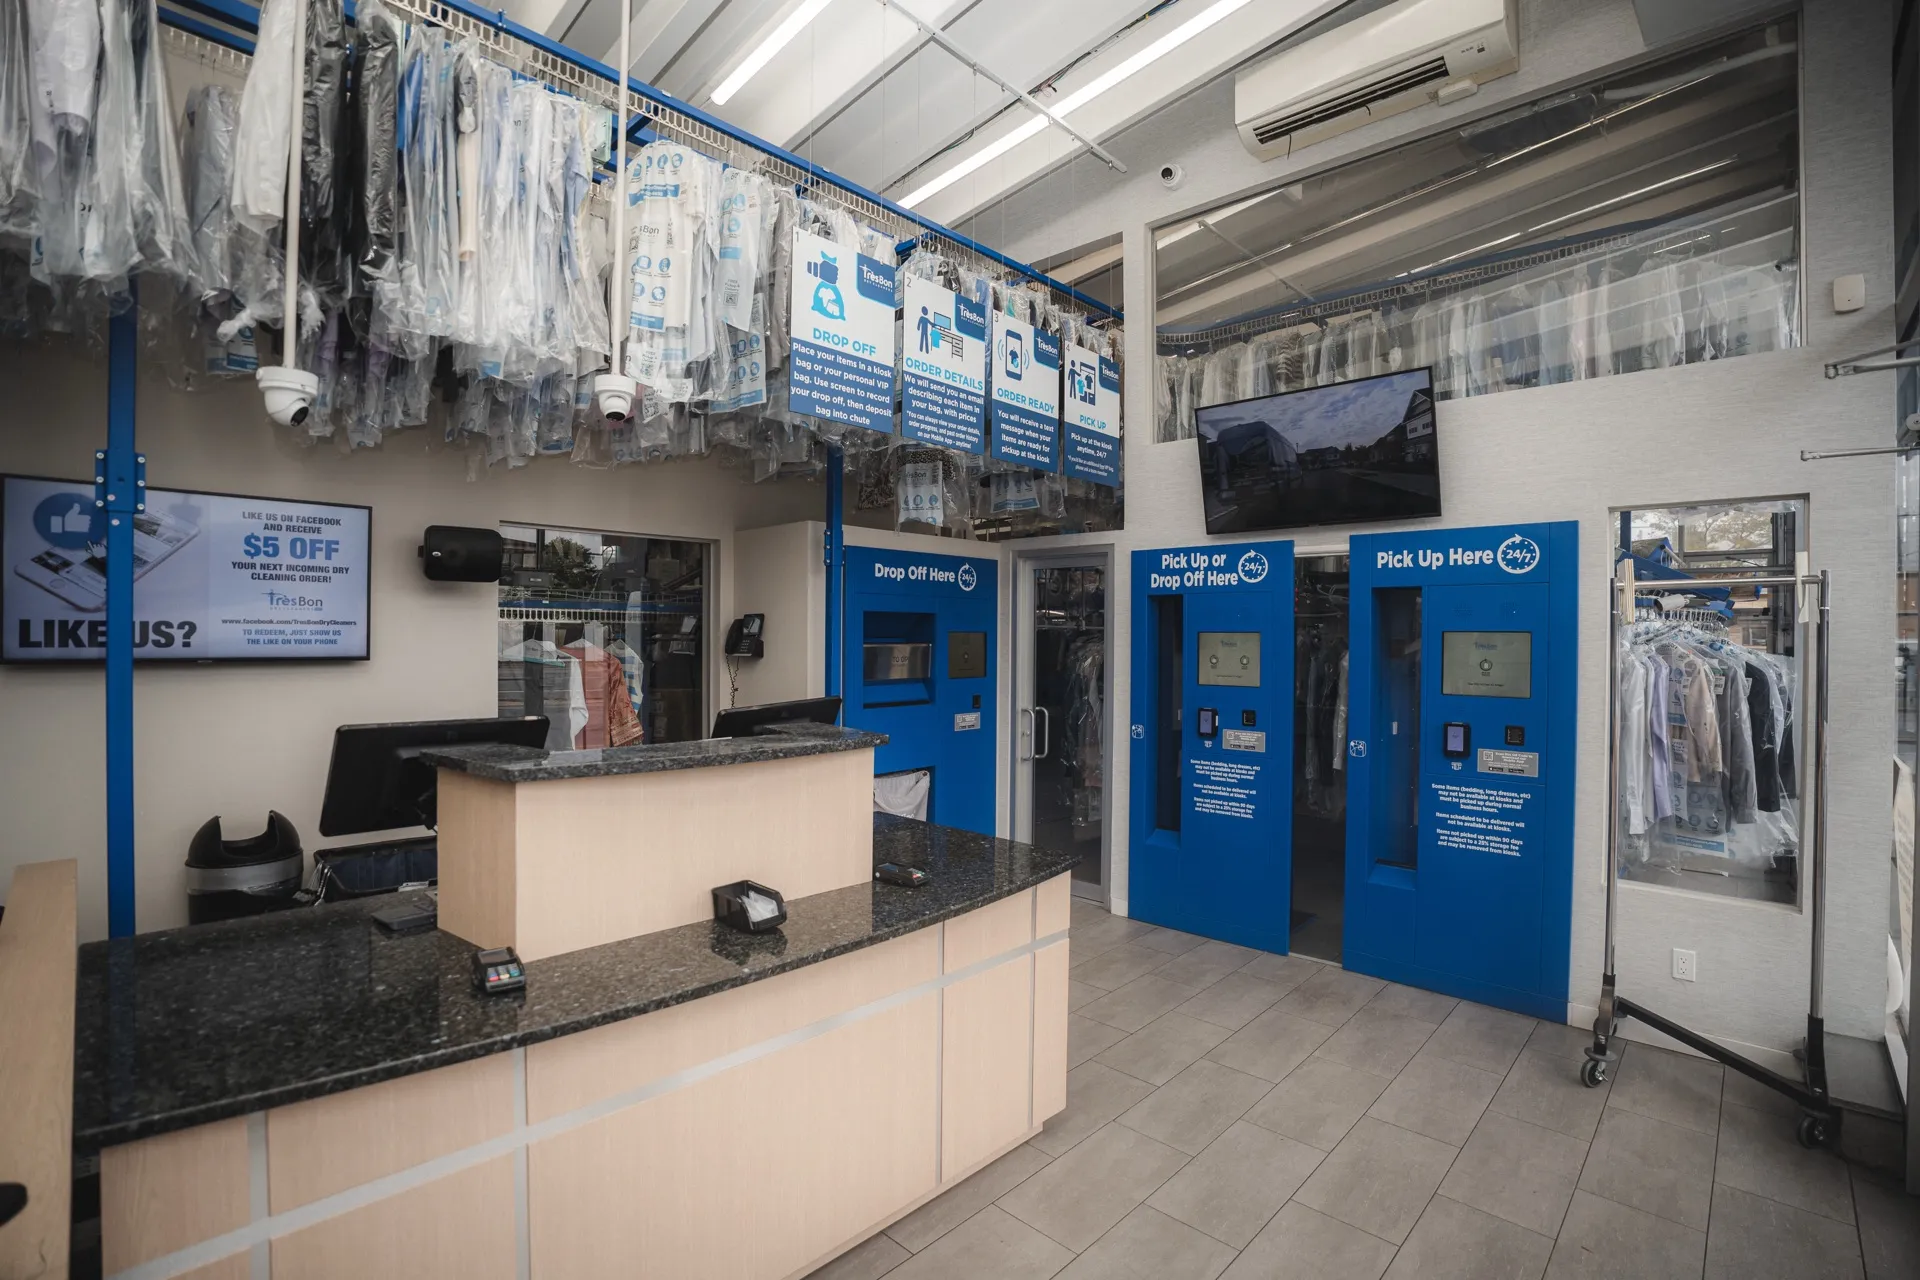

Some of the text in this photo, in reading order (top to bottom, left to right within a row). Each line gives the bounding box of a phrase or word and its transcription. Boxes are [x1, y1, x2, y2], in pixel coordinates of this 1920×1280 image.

[906, 277, 912, 288] 2
[813, 328, 876, 356] DROP OFF
[793, 342, 815, 356] Place
[817, 350, 835, 361] your
[836, 355, 857, 368] items
[859, 361, 866, 370] in
[873, 366, 892, 378] kiosk
[796, 357, 812, 370] bag
[824, 366, 842, 377] your
[844, 372, 875, 386] personal
[876, 380, 889, 389] VIP
[906, 357, 983, 391] ORDER DETAILS
[794, 371, 890, 404] bag. Use screen to record
[904, 374, 916, 384] We
[917, 379, 929, 388] will
[930, 383, 945, 393] send
[946, 388, 958, 397] you
[968, 395, 984, 405] email
[791, 386, 892, 417] your drop off, then deposit
[908, 386, 942, 404] describing
[944, 398, 958, 407] each
[960, 401, 973, 412] item
[997, 388, 1055, 414] ORDER READY
[816, 405, 870, 425] bag into chute
[912, 399, 976, 423] your bag, with prices
[998, 409, 1009, 419] You
[1020, 418, 1039, 428] receive
[1044, 424, 1054, 432] text
[1000, 423, 1024, 435] message
[1025, 430, 1039, 438] when
[1080, 414, 1106, 430] PICK UP
[1002, 433, 1017, 444] items
[1027, 442, 1042, 451] ready
[1071, 432, 1080, 441] Pick
[1101, 442, 1112, 450] kiosk
[1002, 445, 1020, 456] pickup
[1036, 454, 1050, 463] kiosk
[242, 511, 262, 520] LIKE
[266, 513, 278, 521] US
[296, 516, 341, 526] FACEBOOK
[263, 523, 321, 534] AND RECEIVE
[244, 532, 340, 560] $5 OFF
[1162, 553, 1226, 570] Pick Up or
[1377, 548, 1494, 570] Pick Up Here
[1506, 549, 1531, 563] 24/7
[232, 562, 256, 570] YOUR
[260, 563, 283, 571] NEXT
[286, 564, 330, 573] INCOMING
[874, 563, 956, 582] Drop Off Here
[1245, 562, 1262, 574] 24/7
[251, 572, 331, 583] CLEANING ORDER!
[962, 573, 973, 585] 24/7
[1151, 571, 1238, 590] Drop Off Here
[261, 589, 323, 607] TrèsBon
[19, 620, 197, 648] LIKE US?
